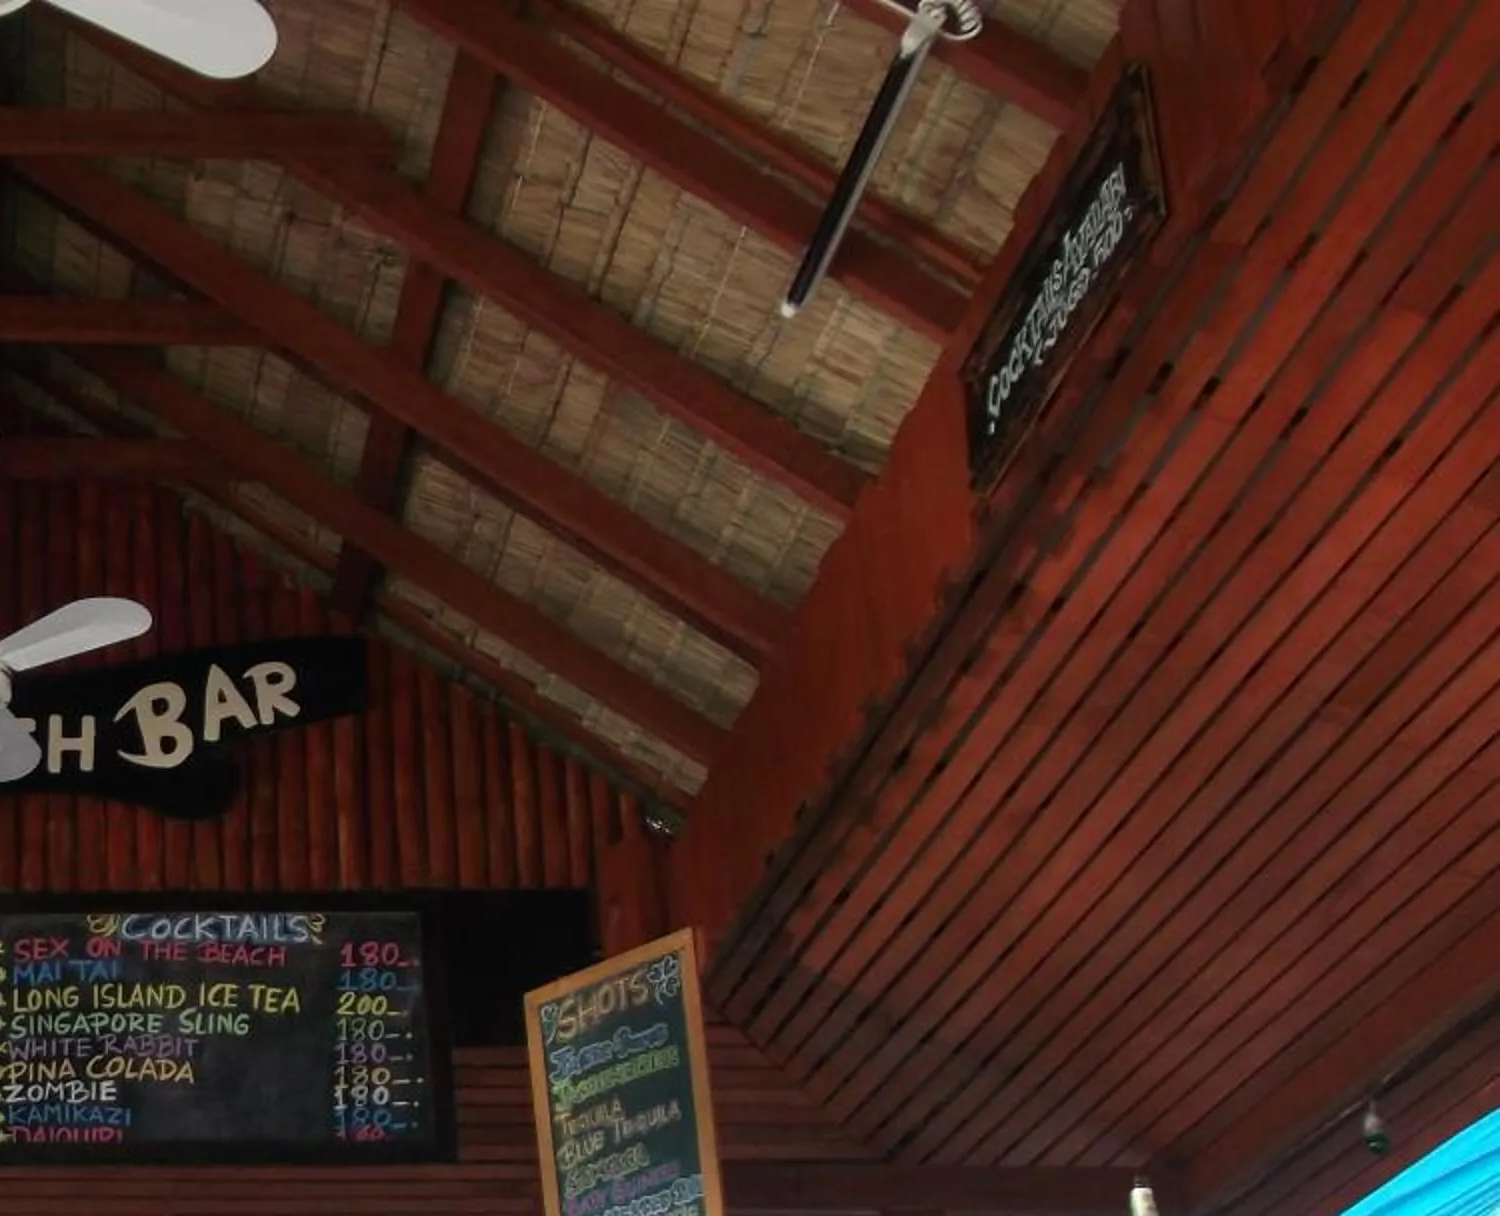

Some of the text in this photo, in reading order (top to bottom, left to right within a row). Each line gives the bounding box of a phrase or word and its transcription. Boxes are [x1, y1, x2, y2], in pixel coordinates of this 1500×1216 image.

[113, 660, 301, 768] BAR
[122, 913, 310, 943] COCKTAILS
[13, 938, 70, 963] SEX
[86, 936, 121, 958] ON
[141, 940, 187, 962] THE
[198, 942, 287, 967] BEACH
[13, 961, 62, 986] MAI
[69, 959, 120, 982] TAI
[13, 986, 79, 1013] LONG
[93, 983, 187, 1010] ISLAND
[199, 983, 240, 1009] ICE
[248, 984, 301, 1013] TEA
[557, 968, 649, 1039] SHOTS
[10, 1012, 163, 1039] SINGAPORE
[179, 1007, 249, 1036] SLING
[8, 1038, 91, 1062] WHITE
[98, 1034, 199, 1058] RABBIT
[6, 1058, 77, 1085] PINA
[86, 1055, 196, 1084] COLADA
[3, 1079, 118, 1104] ZOMBIE
[8, 1104, 132, 1127] KAMIKAZI
[559, 1099, 681, 1168] BLUE TEQUILA
